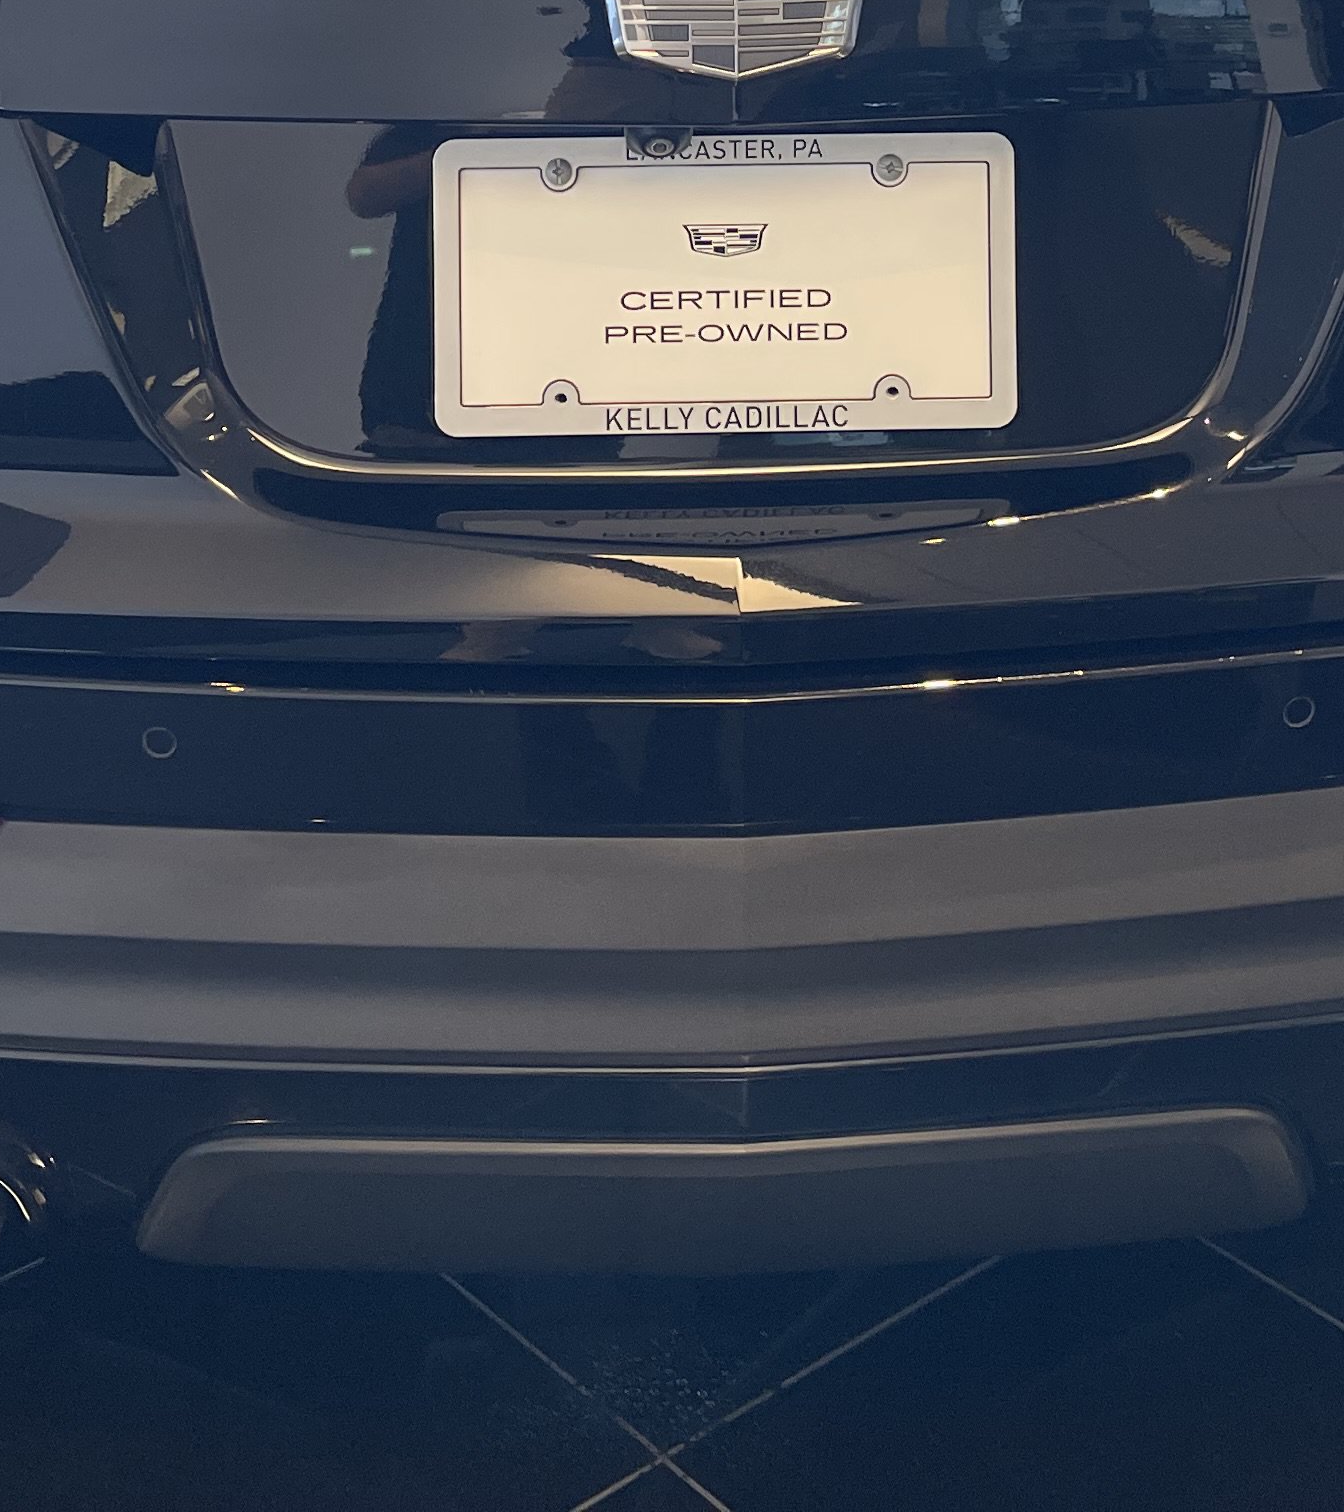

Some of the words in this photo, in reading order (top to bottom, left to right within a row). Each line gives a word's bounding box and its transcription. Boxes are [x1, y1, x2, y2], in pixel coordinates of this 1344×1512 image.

[626, 140, 783, 160] LCASTER,
[793, 139, 823, 159] PA
[620, 289, 831, 310] CERTIFIED
[604, 323, 848, 343] PRE-OWNED
[605, 407, 695, 431] KELLY
[704, 404, 849, 430] CADILLAC
